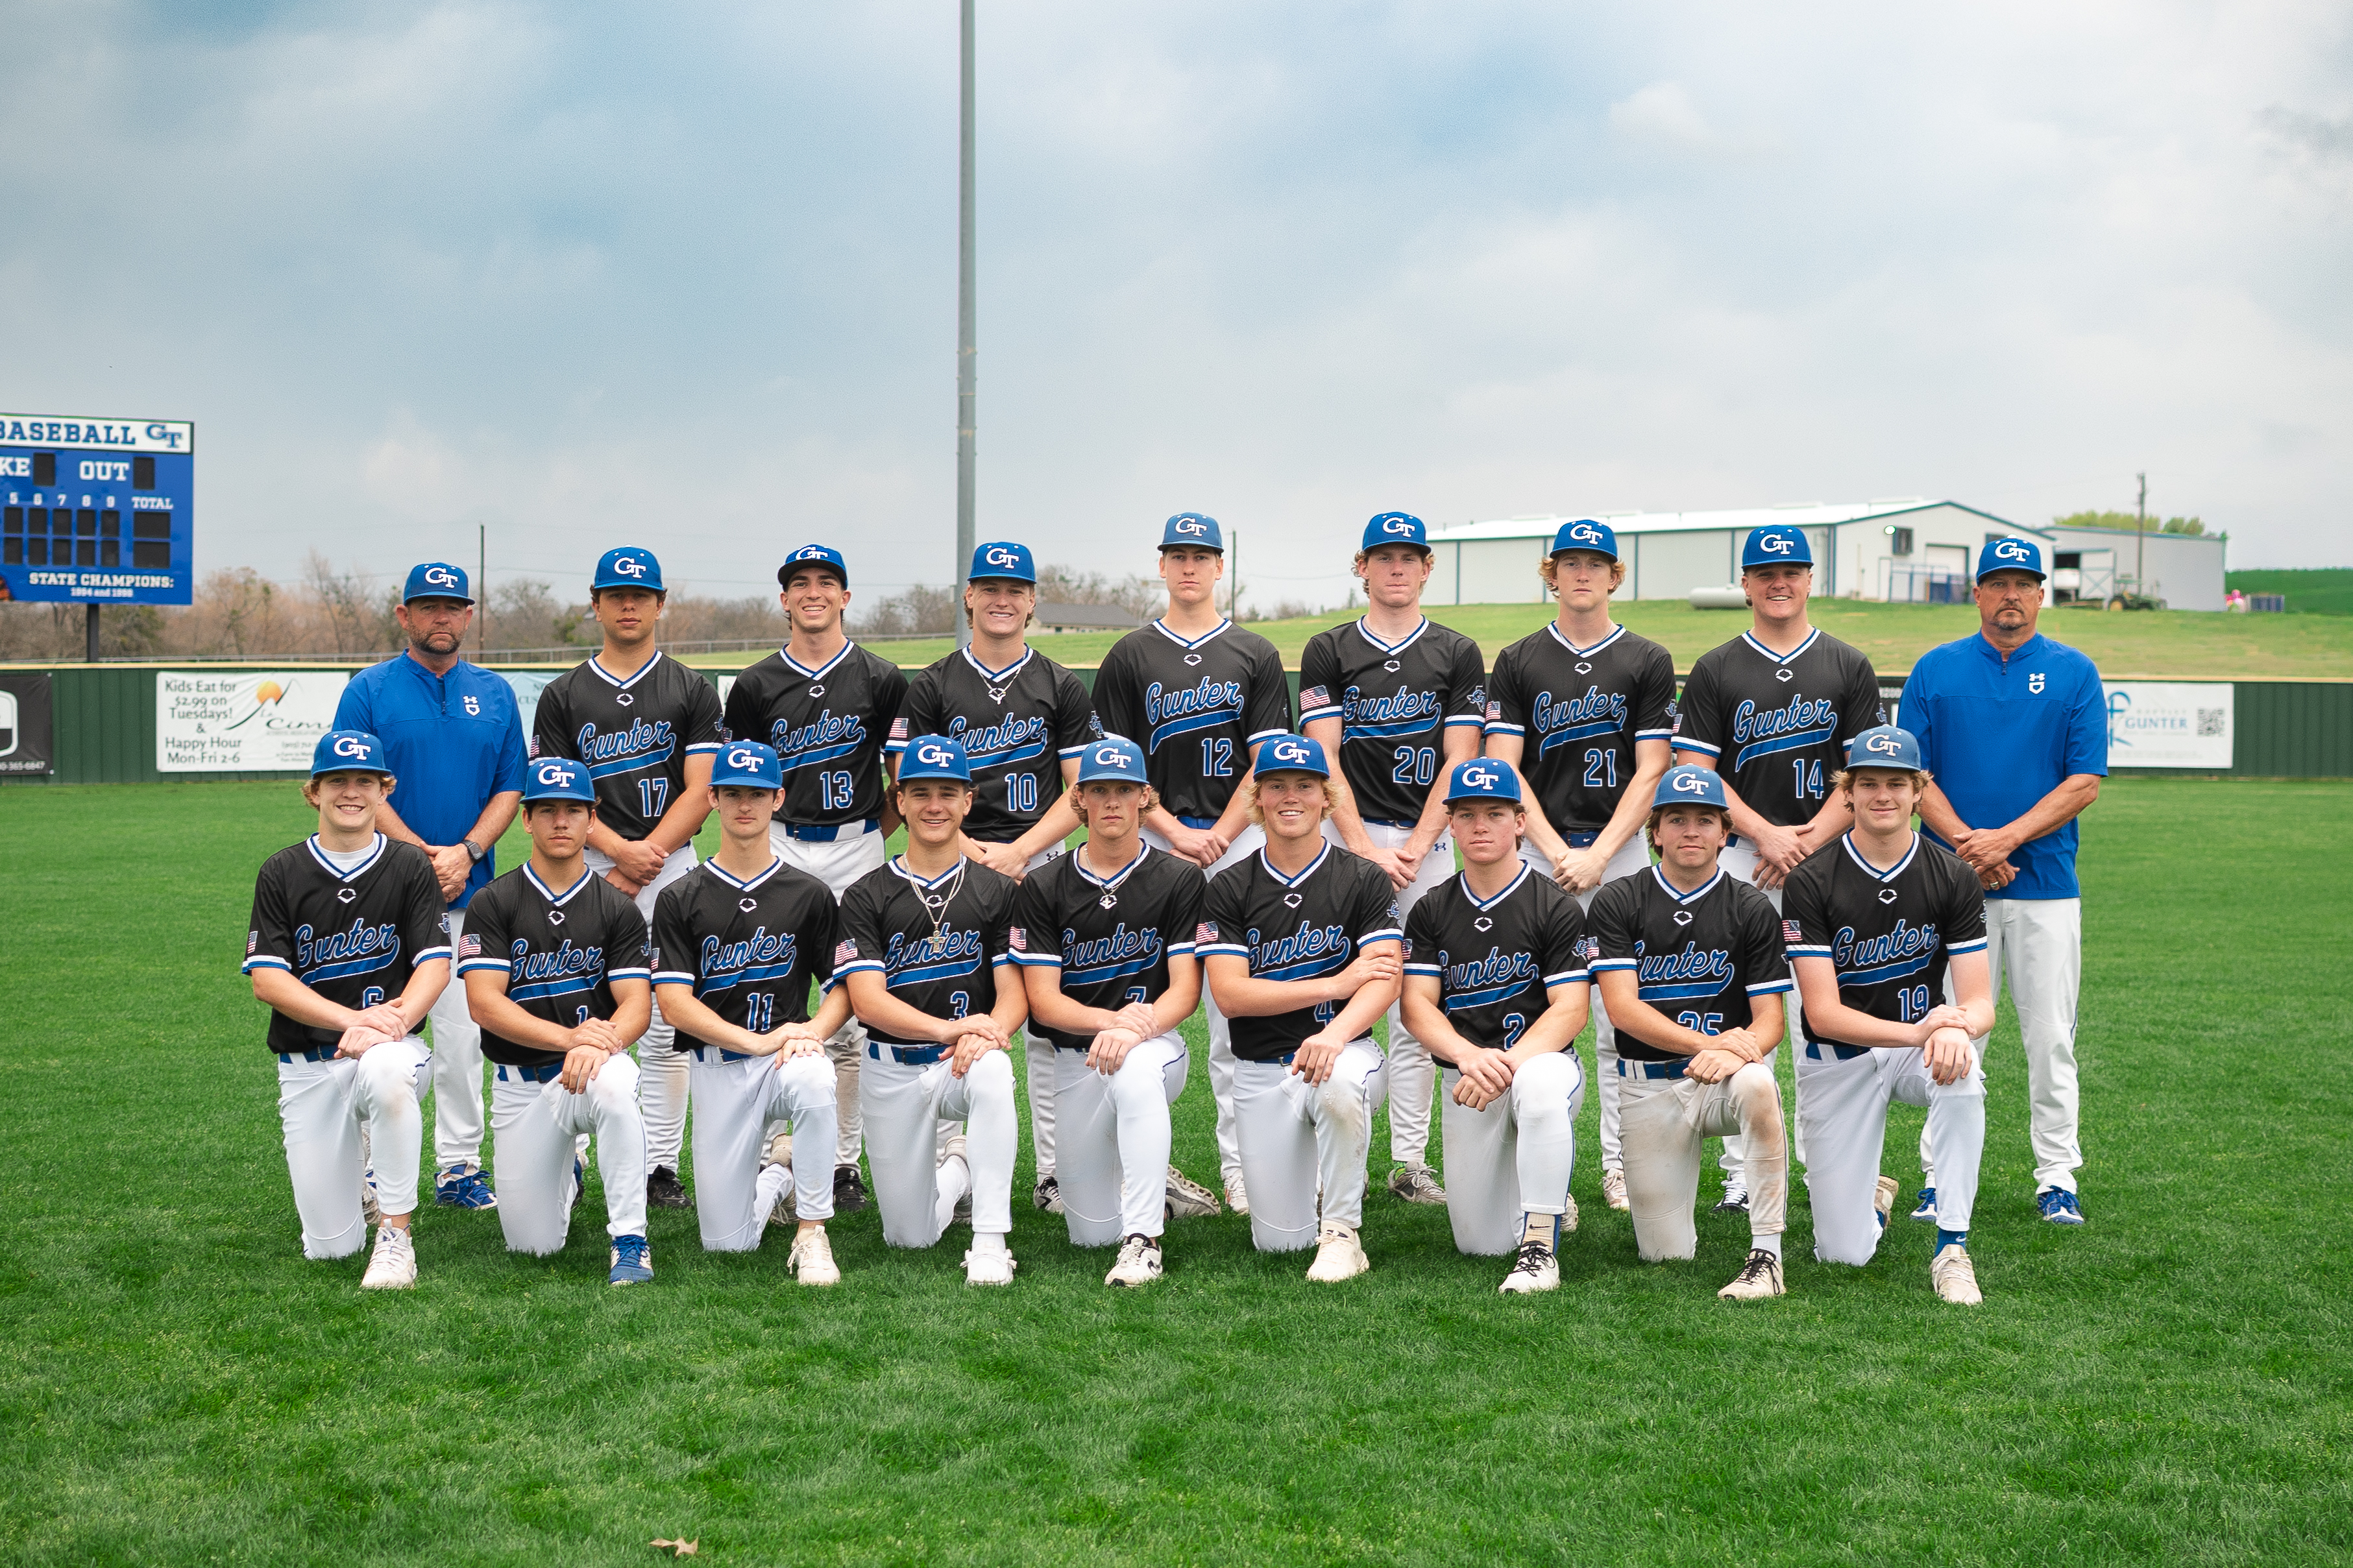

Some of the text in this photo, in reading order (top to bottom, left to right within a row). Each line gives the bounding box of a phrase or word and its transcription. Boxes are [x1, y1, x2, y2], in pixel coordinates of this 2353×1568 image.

[145, 424, 182, 448] GT
[79, 461, 129, 480] OUT
[9, 492, 18, 504] 5
[57, 494, 66, 506] 7
[82, 495, 91, 507] 8
[106, 496, 115, 507] 9
[131, 496, 173, 509] TOTAL
[1175, 517, 1207, 536] GT
[1382, 517, 1415, 538] GT
[1570, 524, 1603, 544] GT
[1760, 534, 1794, 555] GT
[1995, 542, 2030, 562] GT
[615, 557, 646, 579] GT
[986, 548, 1019, 569] GT
[29, 572, 175, 588] STATE CHAMPIONS:
[425, 567, 458, 588] GT
[94, 588, 110, 597] and
[165, 680, 236, 692] Kids Eat for
[175, 696, 227, 708] $2.99 on
[1145, 675, 1245, 727] Gunter
[1342, 685, 1442, 722] Gunter
[1533, 685, 1628, 734] Gunter
[169, 706, 233, 721] Tuesdays!
[1734, 694, 1838, 743] Gunter
[2125, 717, 2188, 729] GUNTER
[196, 722, 206, 733] &
[772, 709, 866, 754] Gunter
[165, 737, 241, 751] Happy Hour
[334, 738, 371, 760] GT
[578, 717, 676, 766] Gunter
[1273, 742, 1310, 765] GT
[1866, 734, 1901, 758] GT
[167, 752, 240, 763] Mon-Fri 2-6
[727, 749, 764, 773] GT
[918, 744, 954, 767] GT
[1095, 747, 1132, 769] GT
[1201, 738, 1233, 777] 12
[1393, 746, 1435, 786] 20
[538, 764, 575, 788] GT
[1461, 767, 1499, 790] GT
[1583, 749, 1616, 787] 21
[1792, 758, 1824, 799] 14
[820, 771, 853, 810] 13
[1004, 773, 1038, 812] 10
[1672, 772, 1709, 795] GT
[638, 778, 668, 817] 17
[295, 918, 400, 967] Gunter
[701, 926, 797, 978] Gunter
[1061, 923, 1164, 967] Gunter
[1247, 921, 1350, 971] Gunter
[1831, 919, 1940, 967] Gunter
[510, 938, 605, 982] Gunter
[747, 993, 775, 1031] 11
[949, 991, 970, 1022] 3
[1313, 1000, 1335, 1027] 4
[1897, 984, 1929, 1022] 19
[1502, 1012, 1526, 1050] 2
